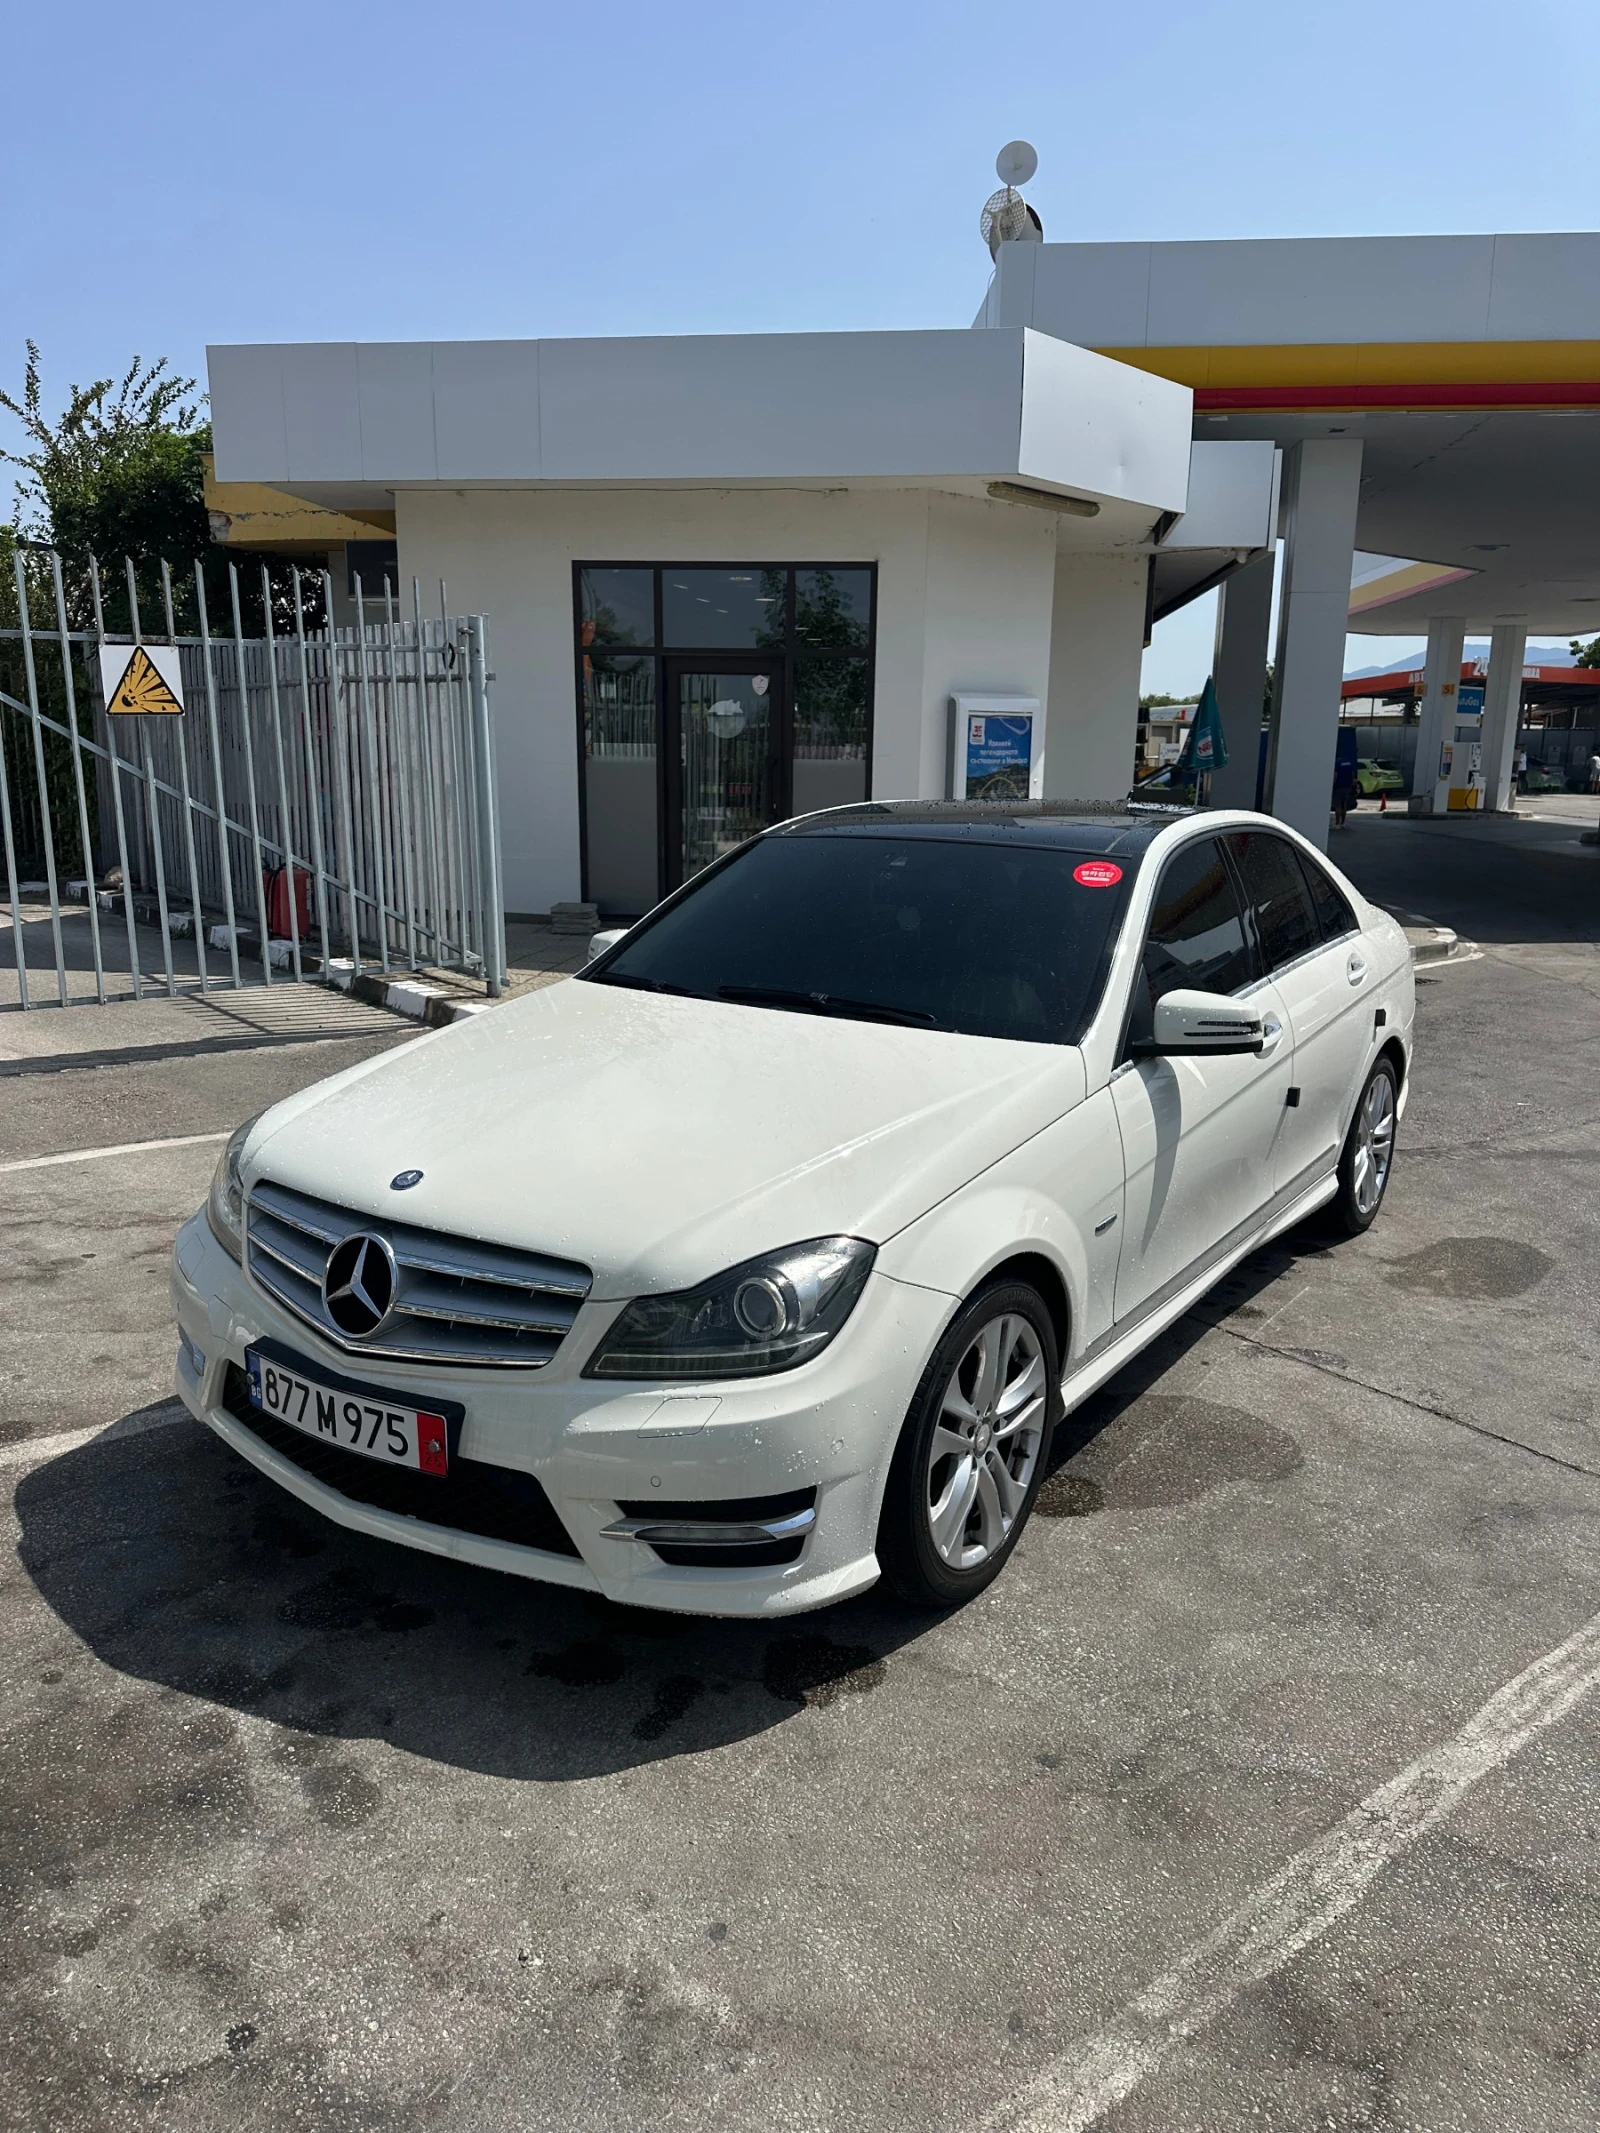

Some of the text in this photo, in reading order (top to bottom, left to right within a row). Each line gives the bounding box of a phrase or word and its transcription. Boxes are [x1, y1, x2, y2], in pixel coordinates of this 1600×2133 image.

[1417, 685, 1423, 694] 6
[1443, 685, 1449, 693] 5
[1003, 1290, 1035, 1306] KUMHO
[251, 1384, 262, 1399] BG
[424, 1451, 442, 1467] 26
